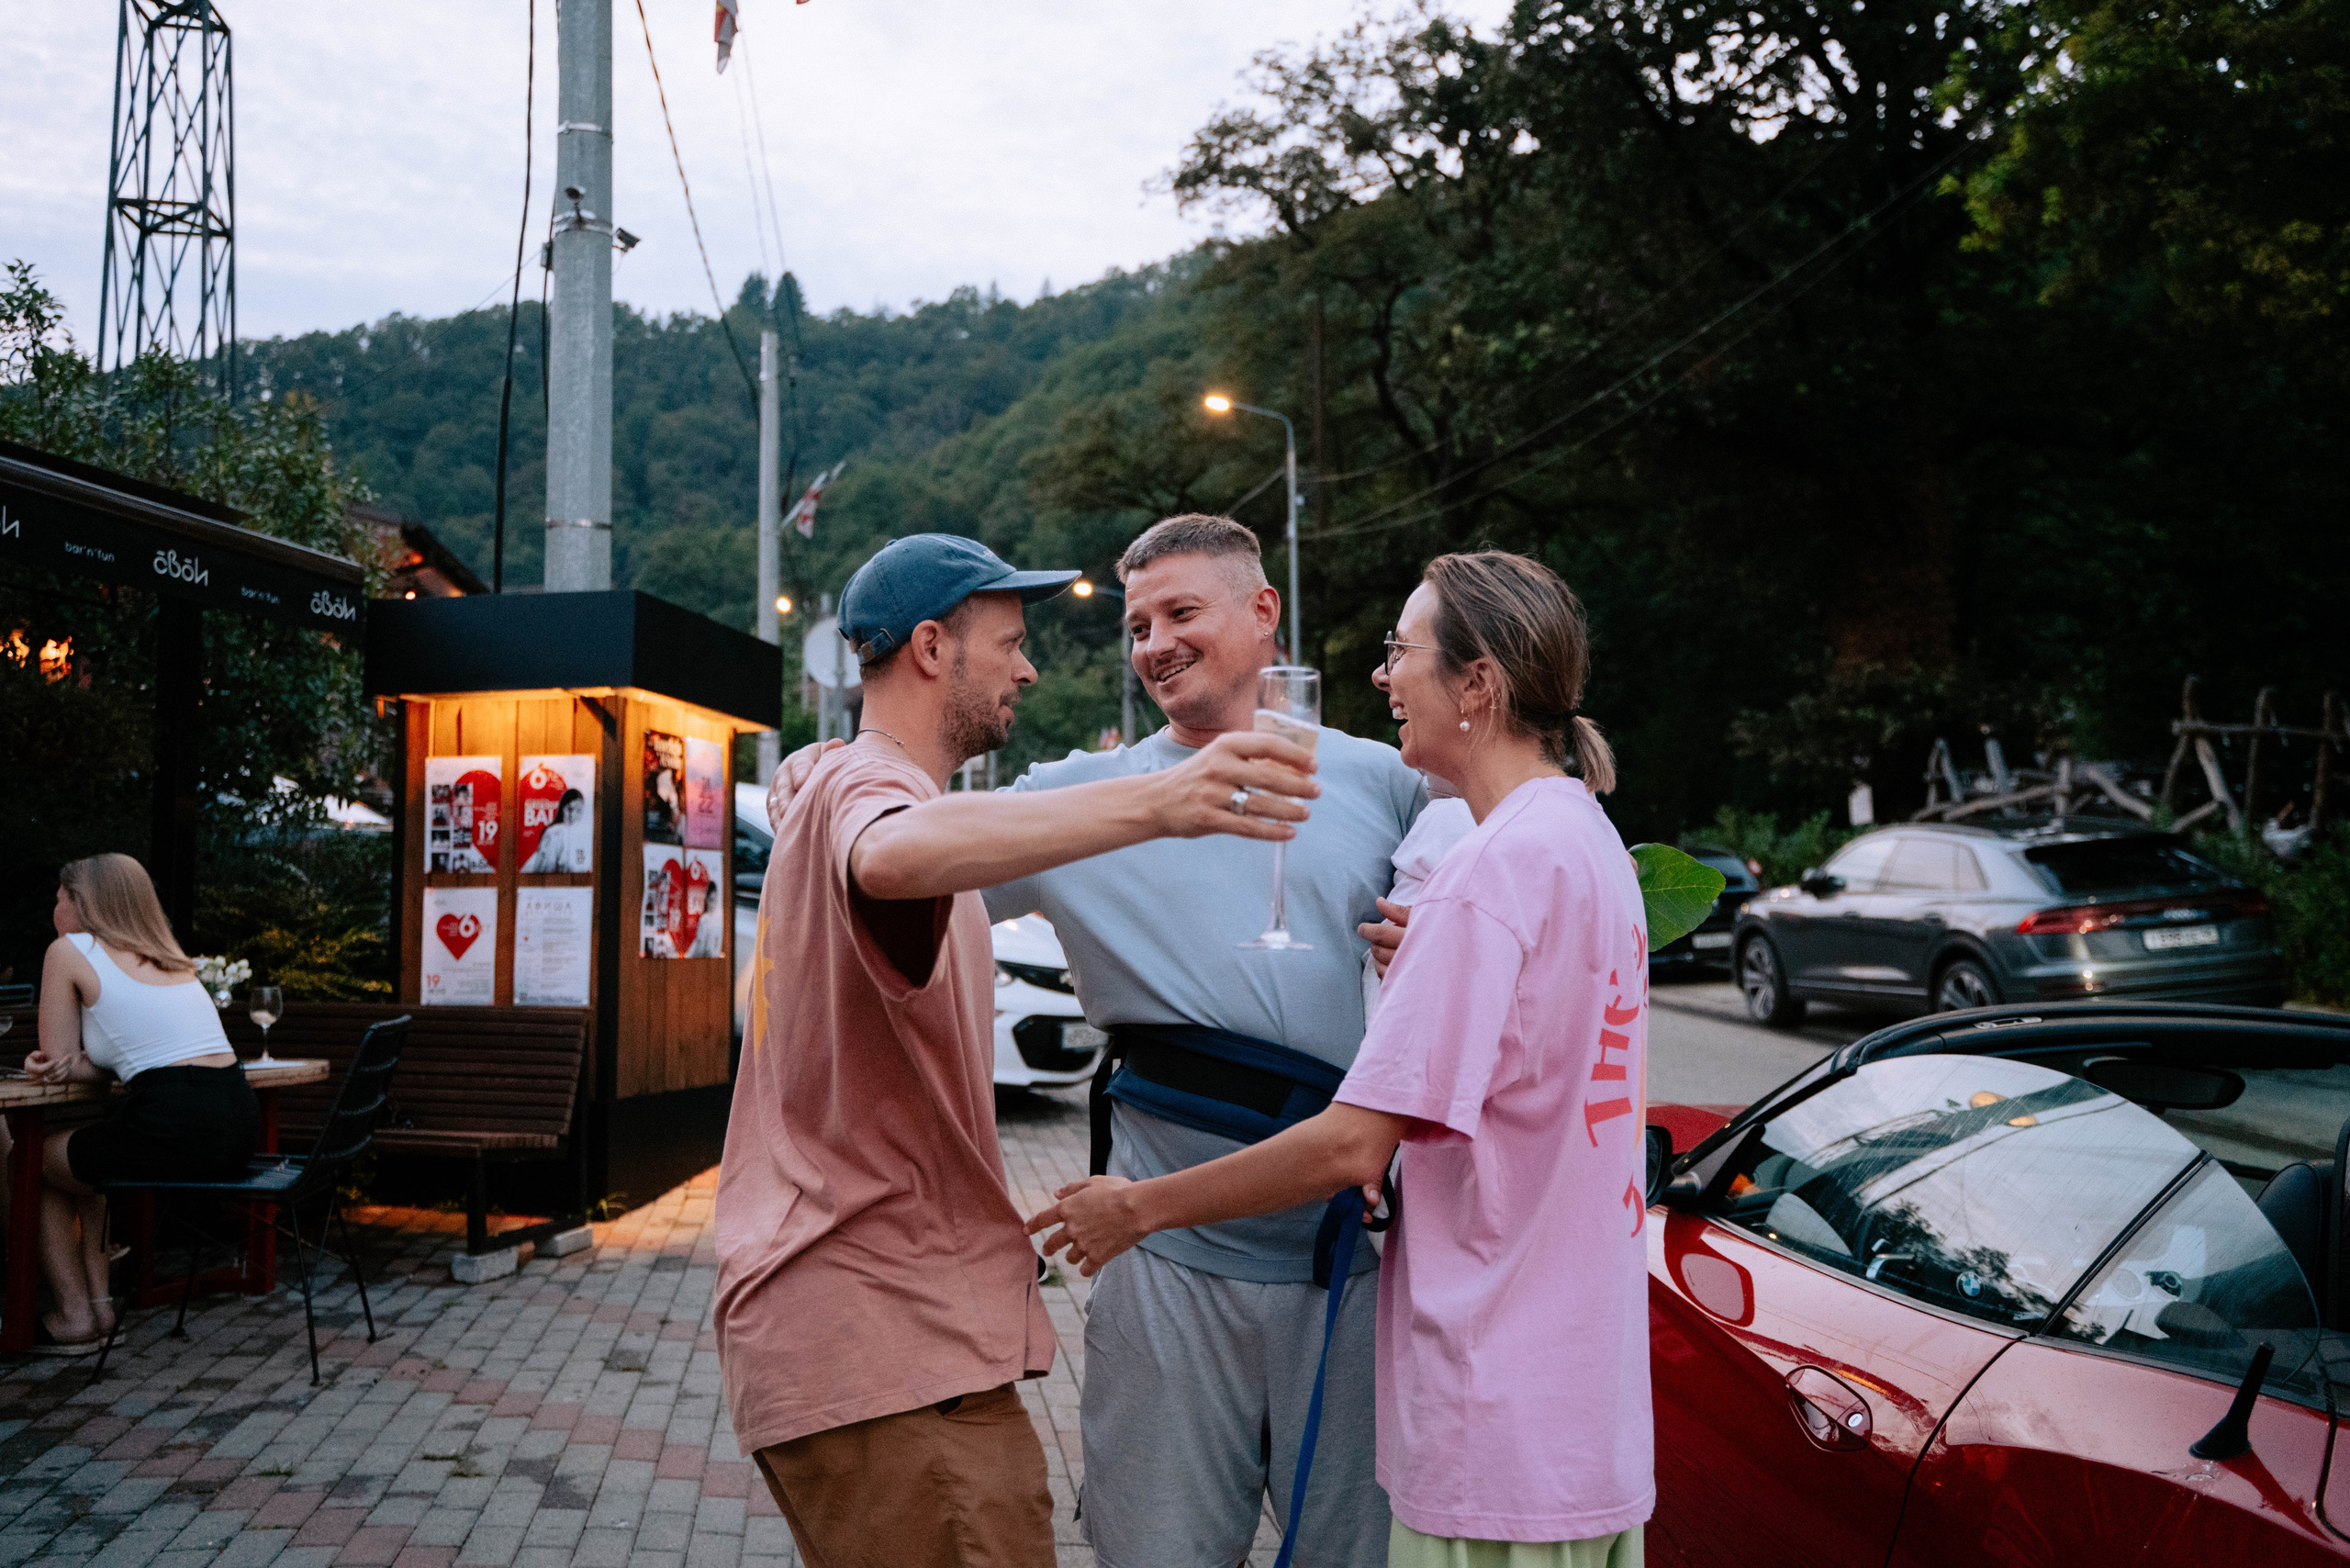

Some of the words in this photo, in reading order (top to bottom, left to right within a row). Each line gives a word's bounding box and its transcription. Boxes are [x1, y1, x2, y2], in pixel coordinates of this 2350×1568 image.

[478, 820, 498, 842] 19
[459, 912, 476, 938] 6
[426, 973, 441, 990] 19
